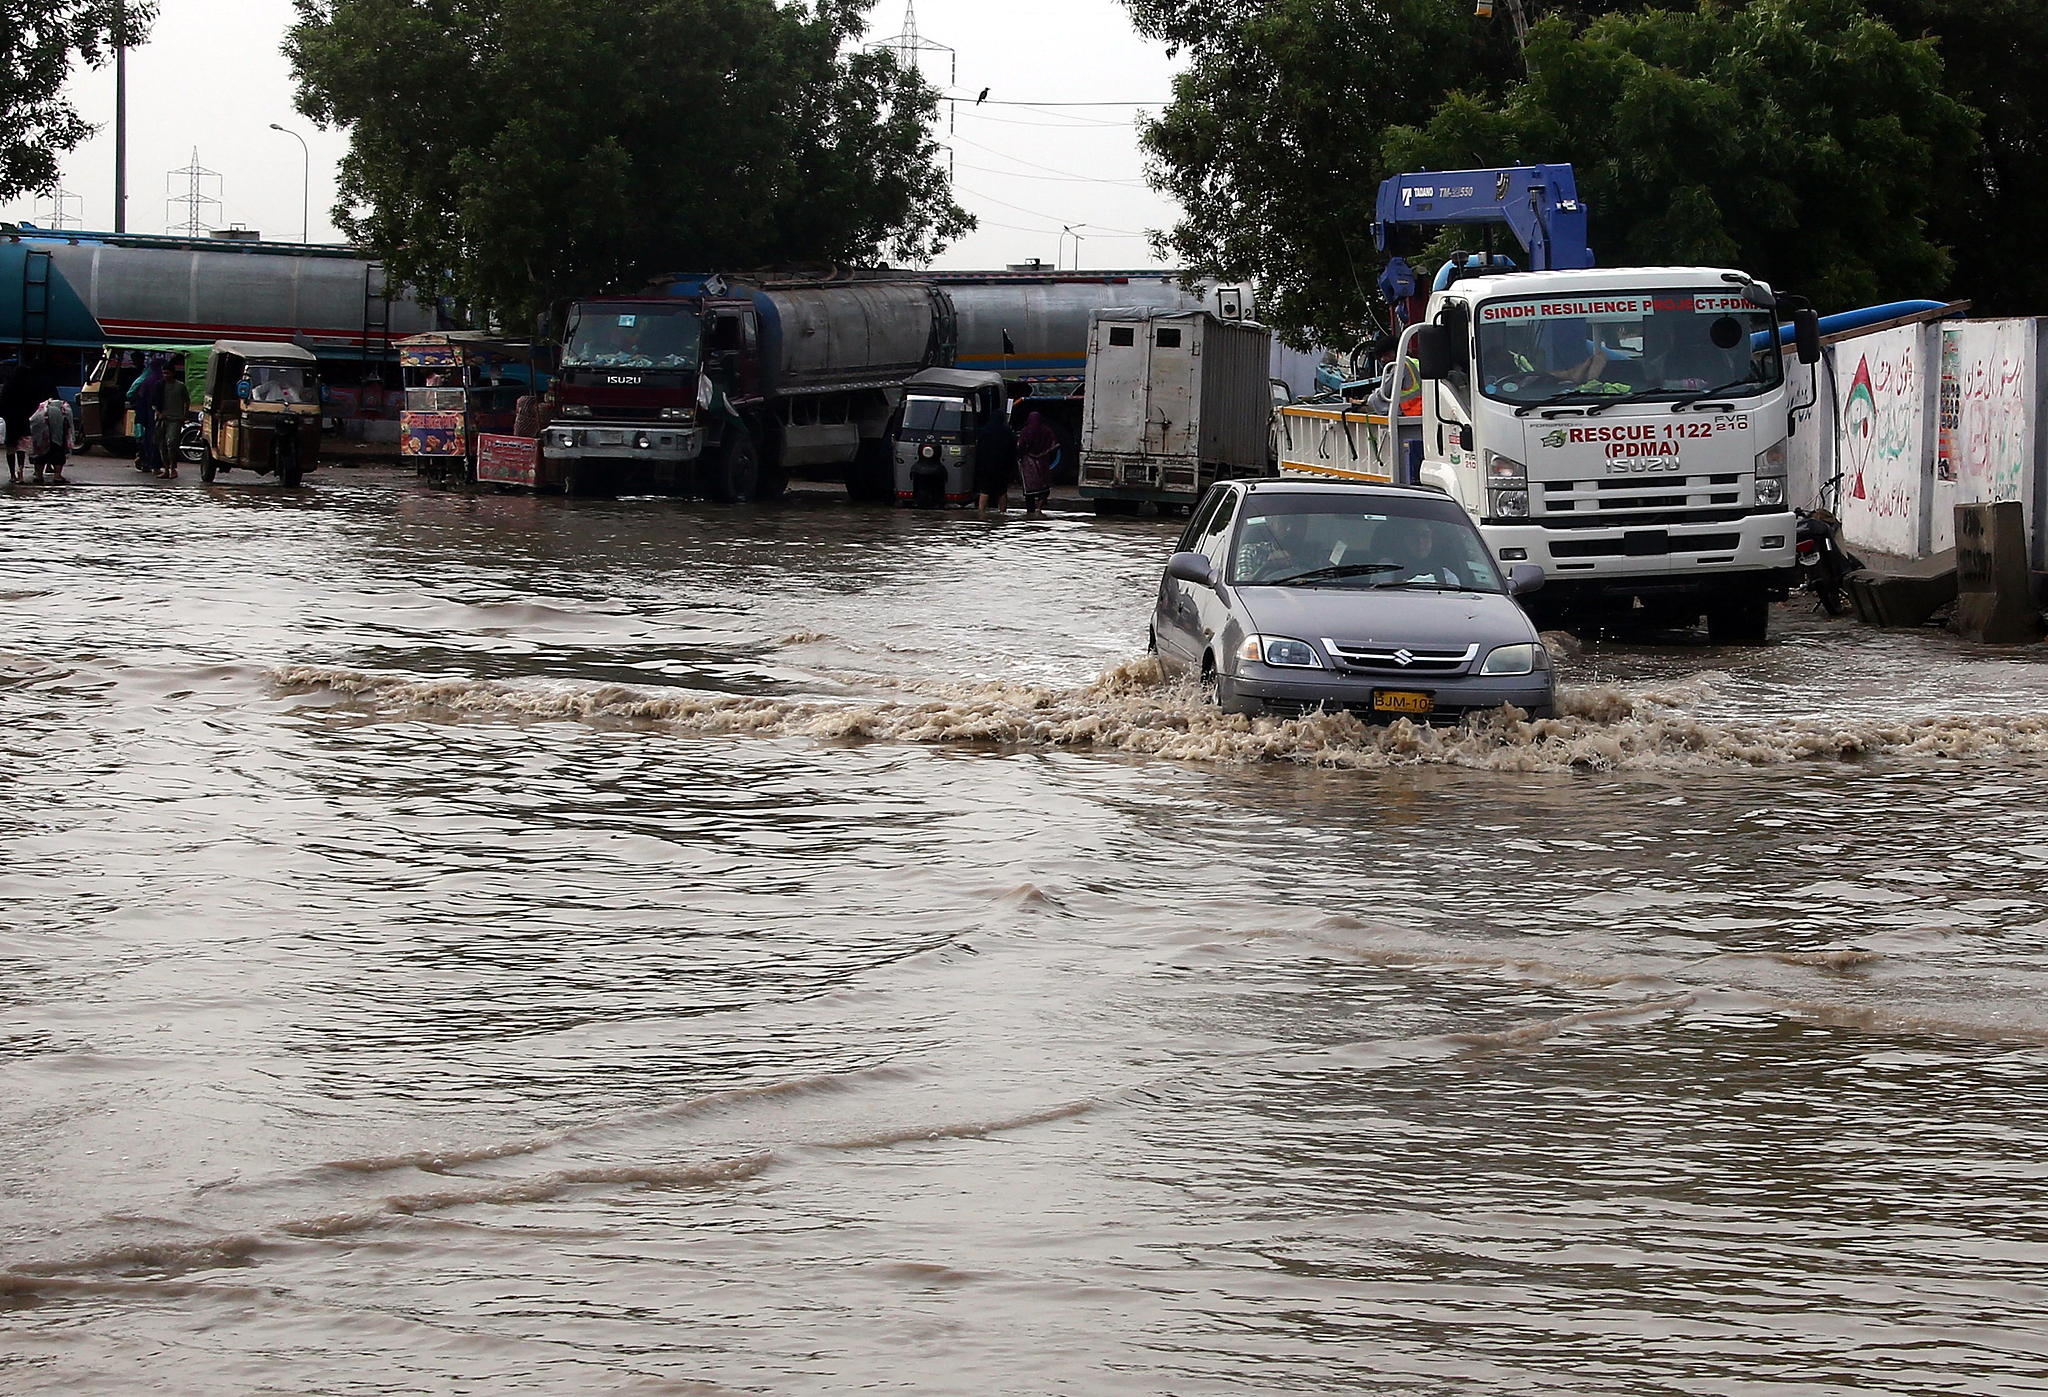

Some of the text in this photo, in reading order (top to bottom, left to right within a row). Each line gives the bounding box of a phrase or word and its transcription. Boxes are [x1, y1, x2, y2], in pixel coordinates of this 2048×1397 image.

[1414, 187, 1434, 197] TADANO
[1484, 298, 1760, 320] SINDH RESILIENCE PROJECT-PDM
[607, 376, 642, 384] ISUZU
[1715, 414, 1748, 423] FVR
[1569, 425, 1656, 443] RESCUE
[1663, 423, 1713, 439] 1122
[1716, 422, 1748, 431] 210
[1605, 440, 1680, 459] (PDMA)
[1605, 457, 1680, 474] ISUZU
